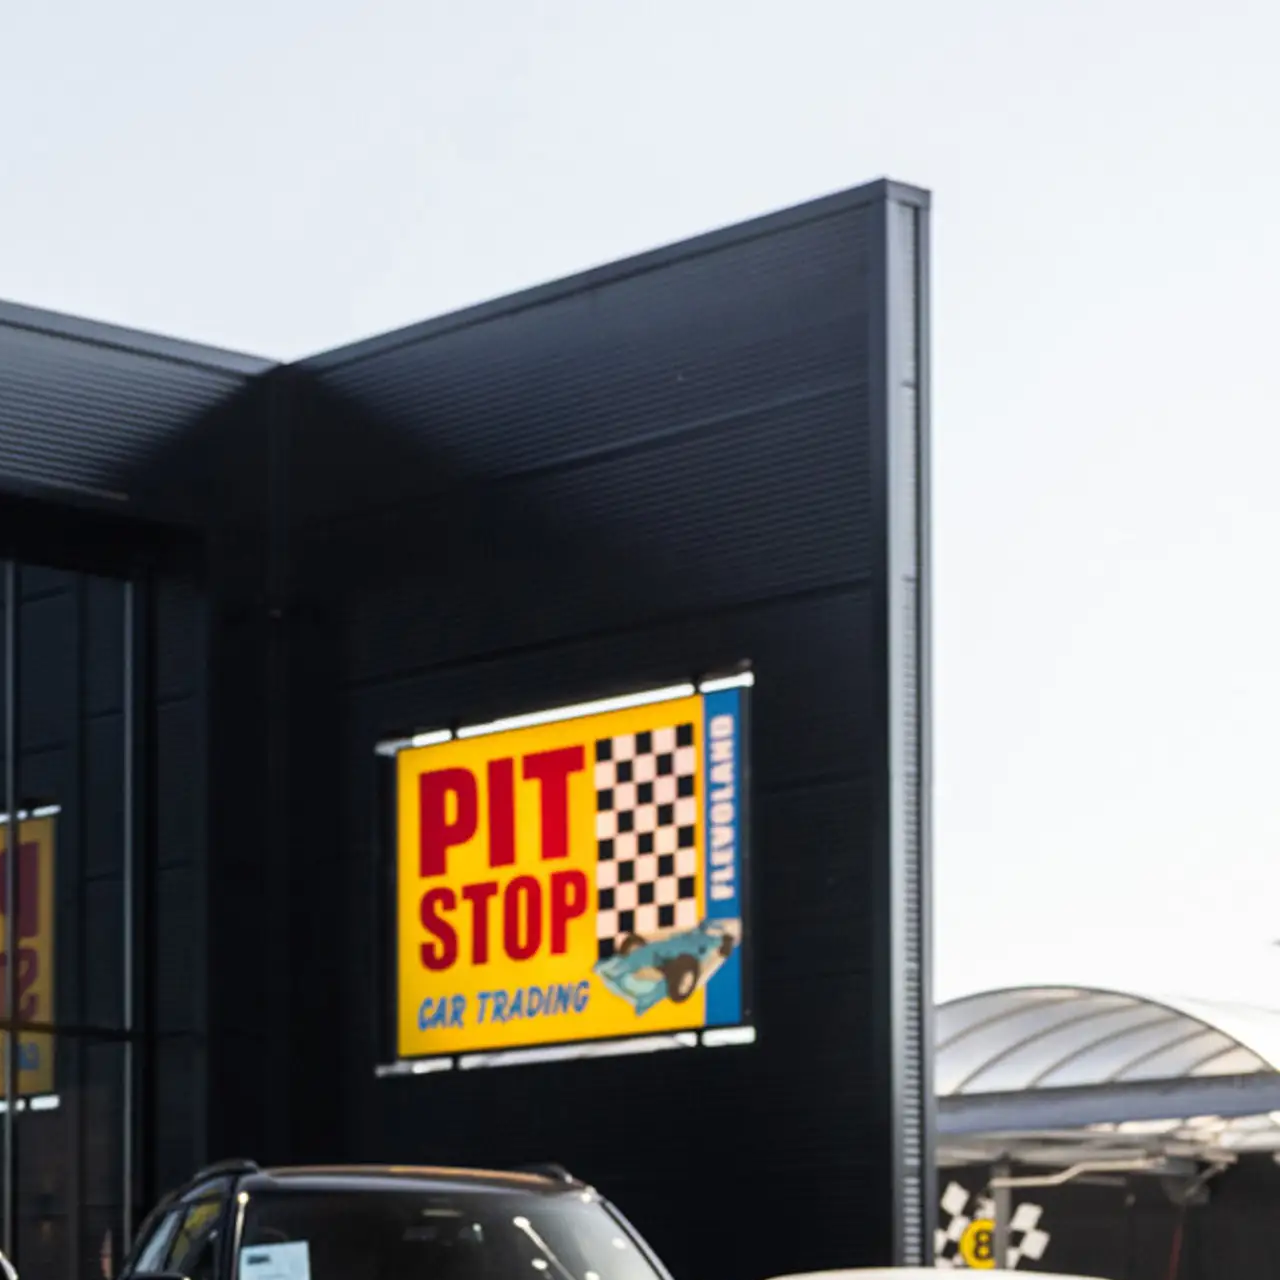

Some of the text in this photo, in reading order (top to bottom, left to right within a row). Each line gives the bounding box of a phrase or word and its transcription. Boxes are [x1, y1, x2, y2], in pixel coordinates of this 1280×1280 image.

[418, 744, 586, 879] PIT
[709, 713, 735, 901] FLEVOLAND
[418, 868, 589, 973] STOP
[417, 980, 590, 1032] CAR TRADING
